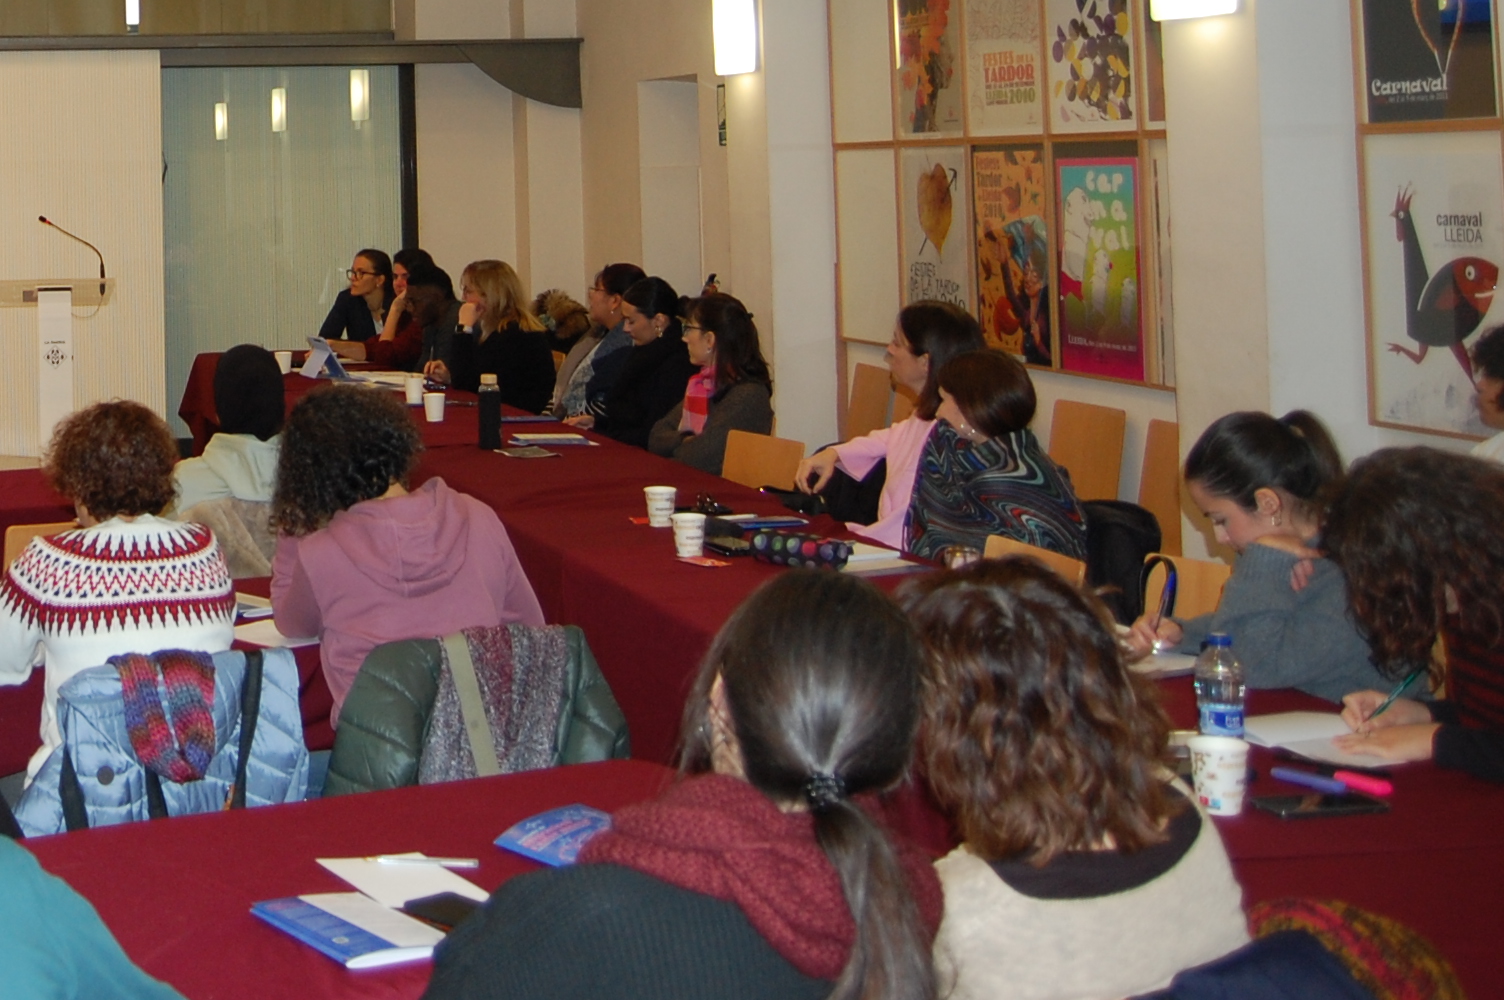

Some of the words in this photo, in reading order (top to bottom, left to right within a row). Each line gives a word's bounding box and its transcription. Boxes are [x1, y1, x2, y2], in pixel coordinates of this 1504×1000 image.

[984, 63, 1034, 83] TARDOR
[1371, 73, 1447, 96] Carnaval
[1009, 87, 1035, 104] 2010
[1436, 211, 1483, 227] carnaval
[1444, 228, 1483, 243] LLEIDA
